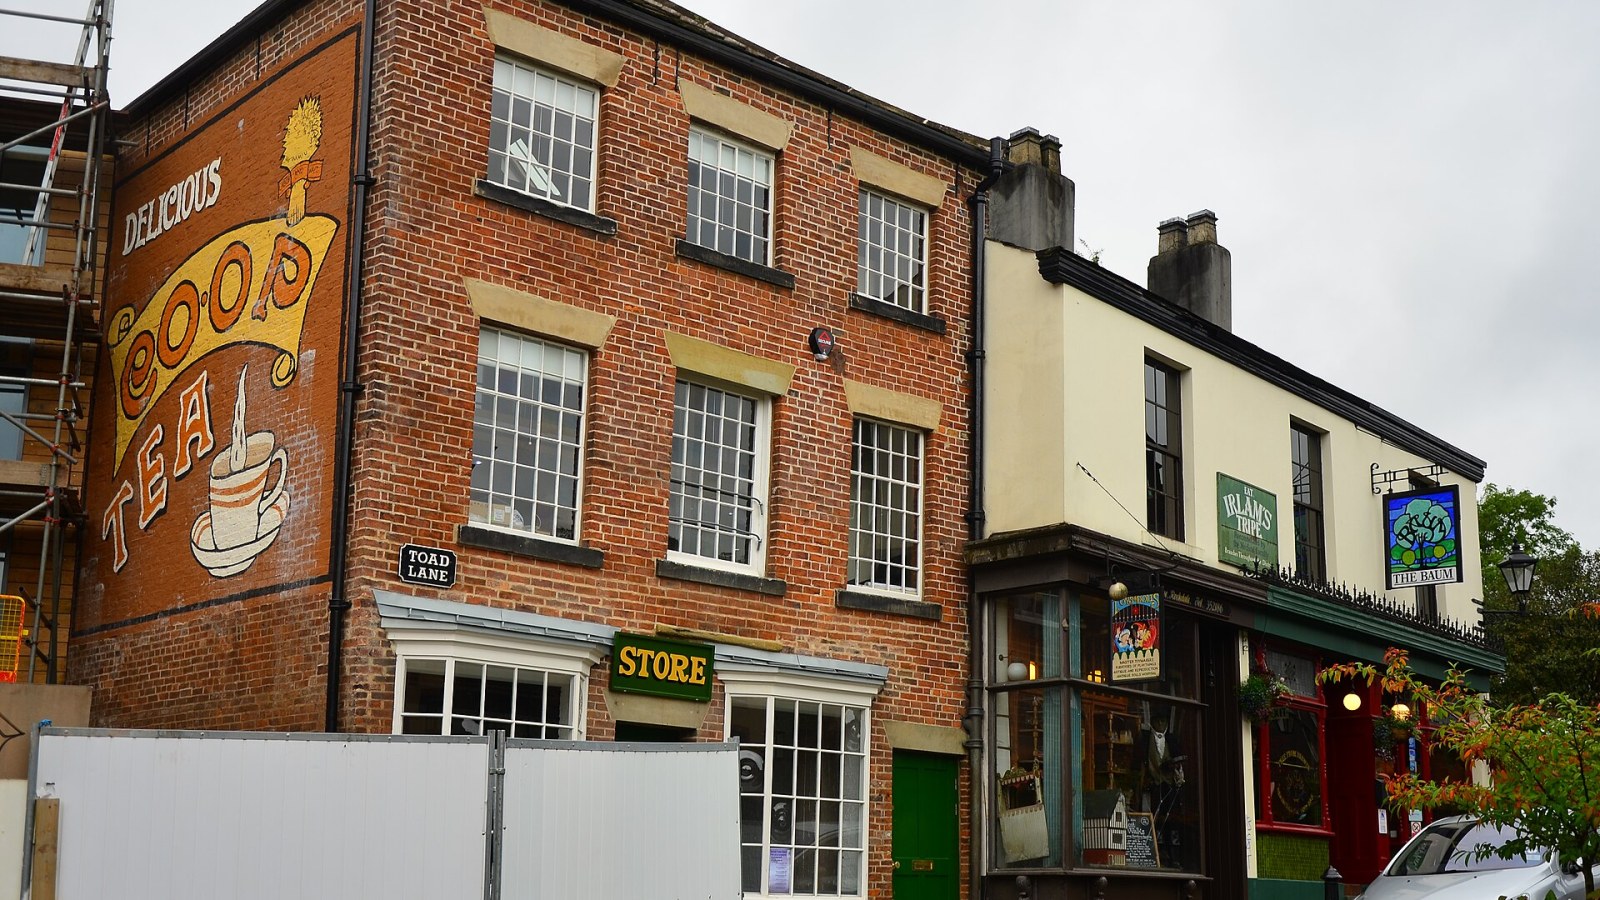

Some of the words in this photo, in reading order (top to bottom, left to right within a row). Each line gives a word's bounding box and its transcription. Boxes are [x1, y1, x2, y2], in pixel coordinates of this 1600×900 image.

[121, 156, 222, 256] DELICIOUS
[102, 369, 215, 576] TEA
[1243, 486, 1254, 497] EAT
[1222, 493, 1273, 531] IRLAM'S
[1236, 514, 1263, 539] TRIPE
[408, 549, 450, 568] TOAD
[407, 564, 449, 583] LANE
[1393, 572, 1418, 584] THE
[1420, 568, 1453, 582] BAUM
[618, 645, 707, 686] STORE
